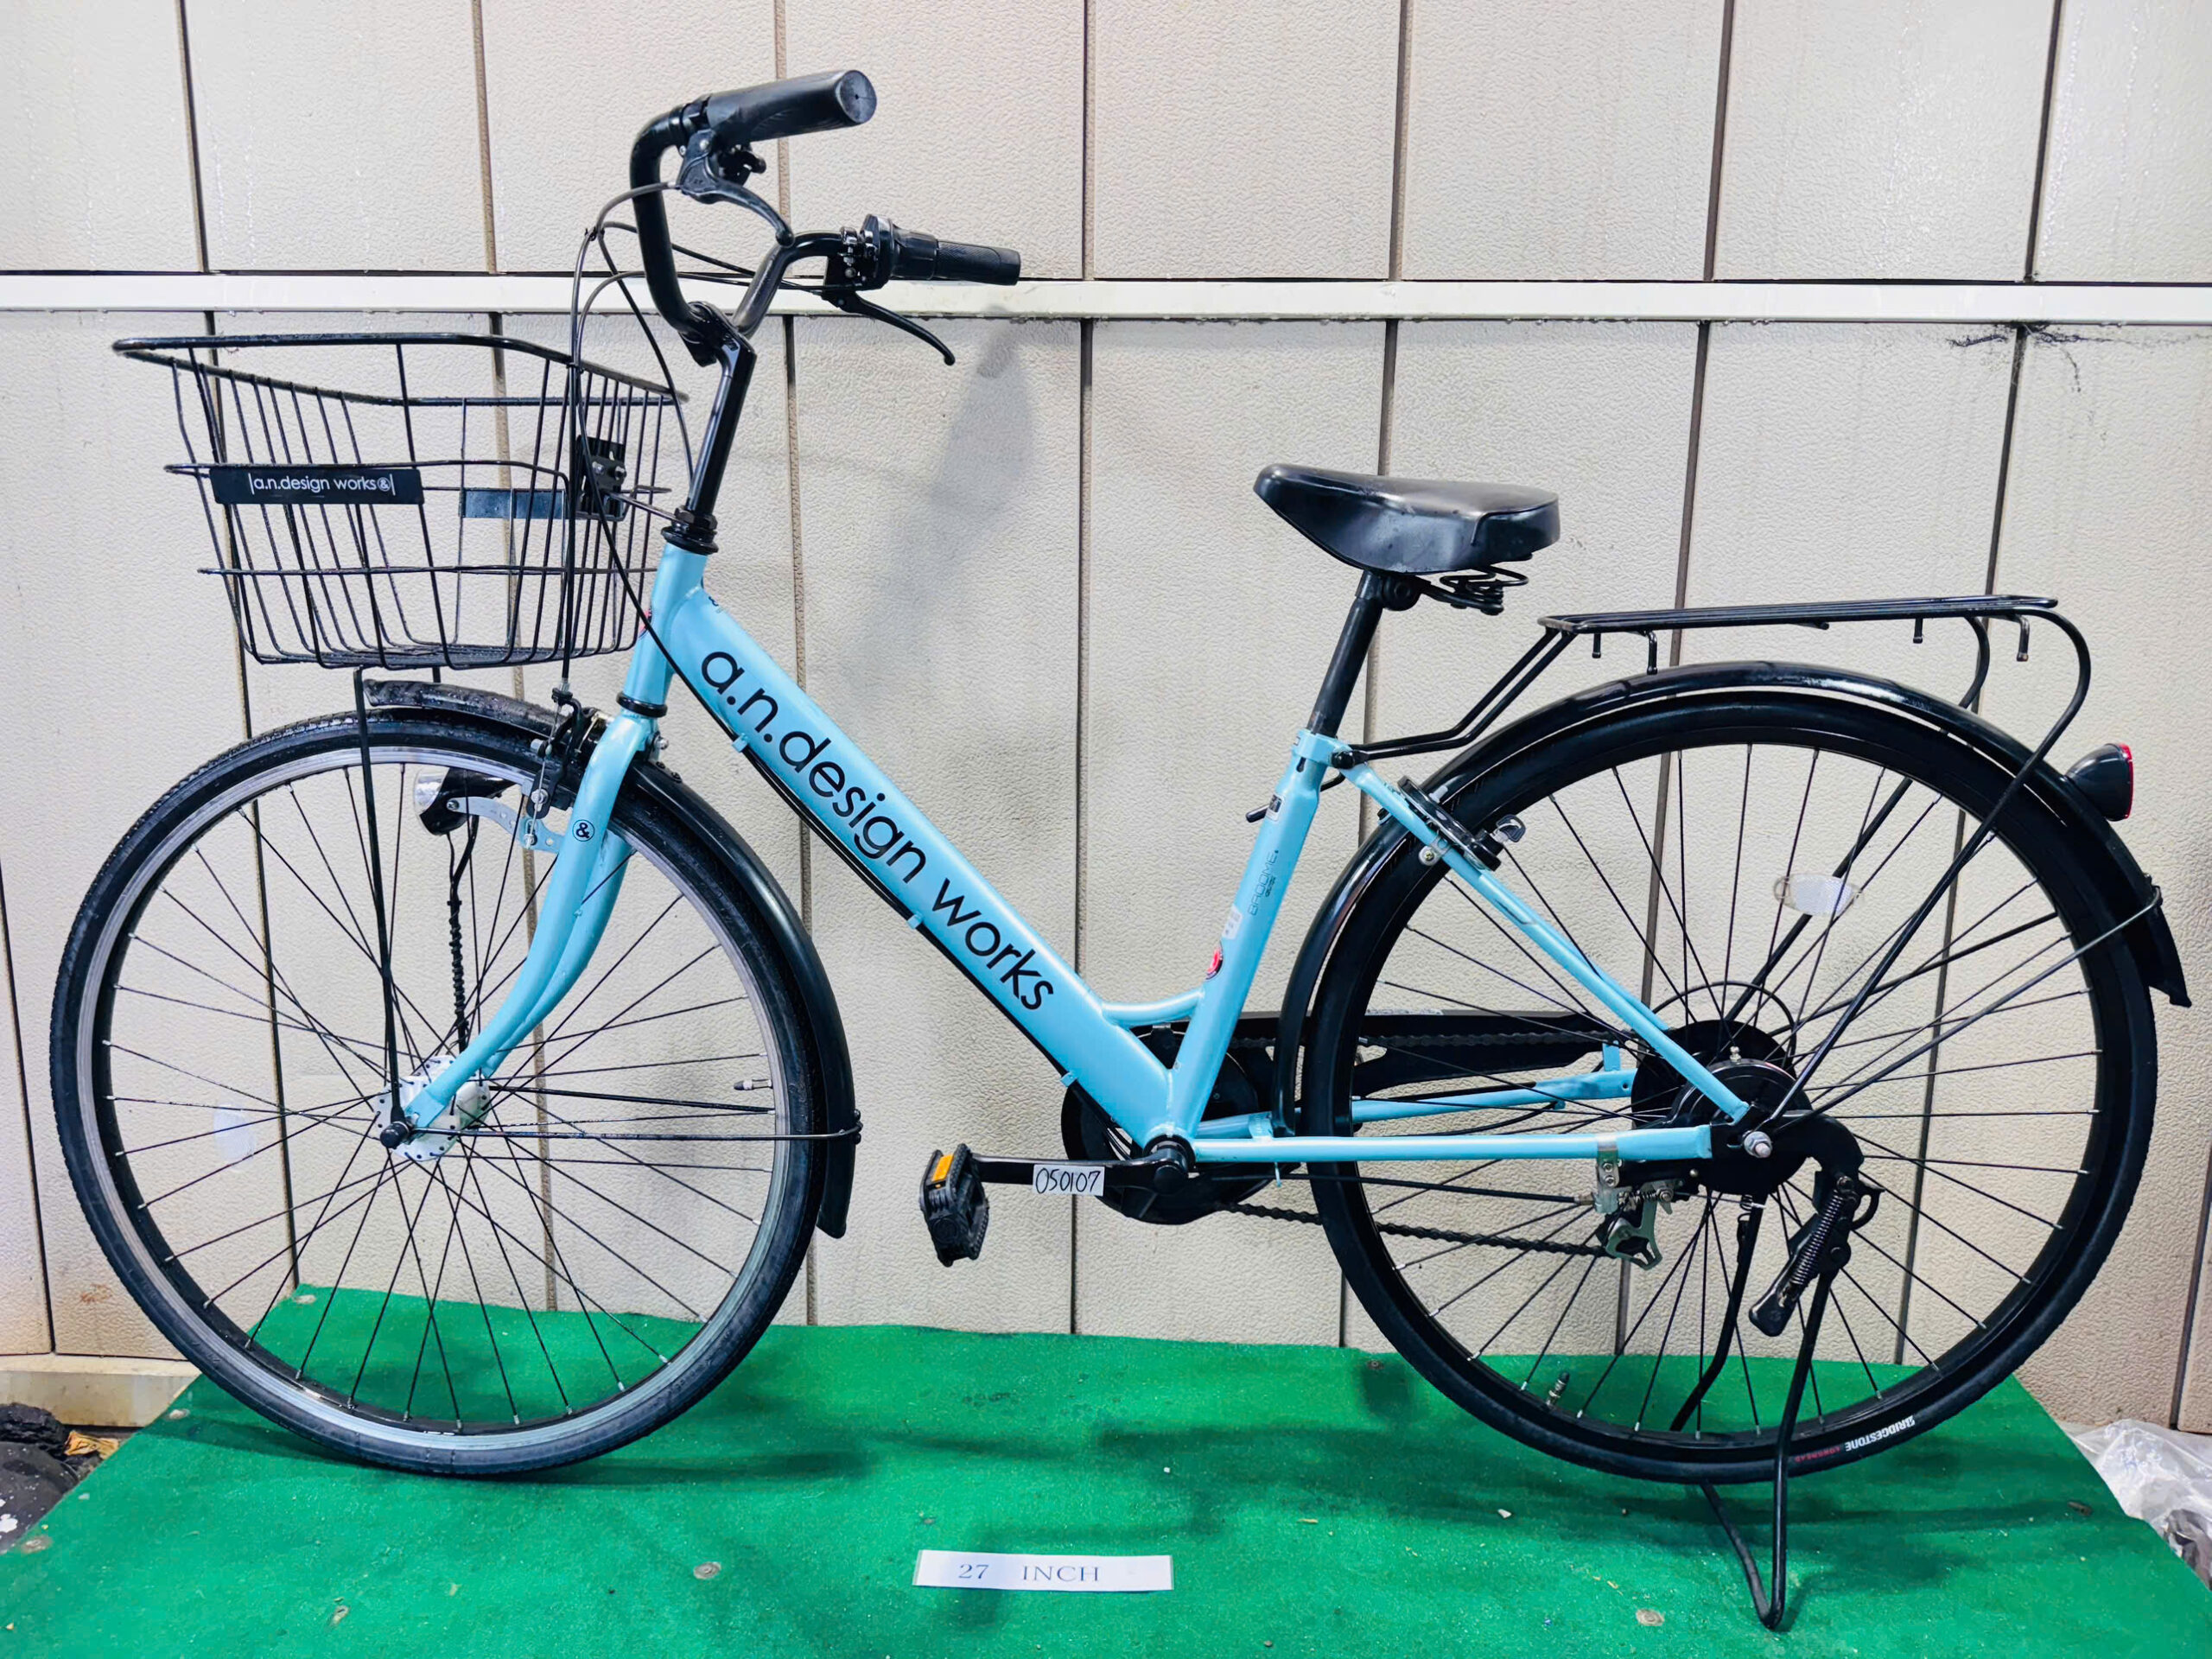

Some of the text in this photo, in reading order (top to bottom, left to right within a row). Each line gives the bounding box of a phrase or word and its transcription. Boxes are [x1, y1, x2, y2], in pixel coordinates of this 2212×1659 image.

[253, 475, 330, 493] a.n.design
[701, 652, 1054, 1011] a.n.design works
[1035, 1167, 1101, 1194] 050107
[1845, 1415, 1916, 1452] BRIDGESTONE
[958, 1563, 1099, 1582] 27 INCH
